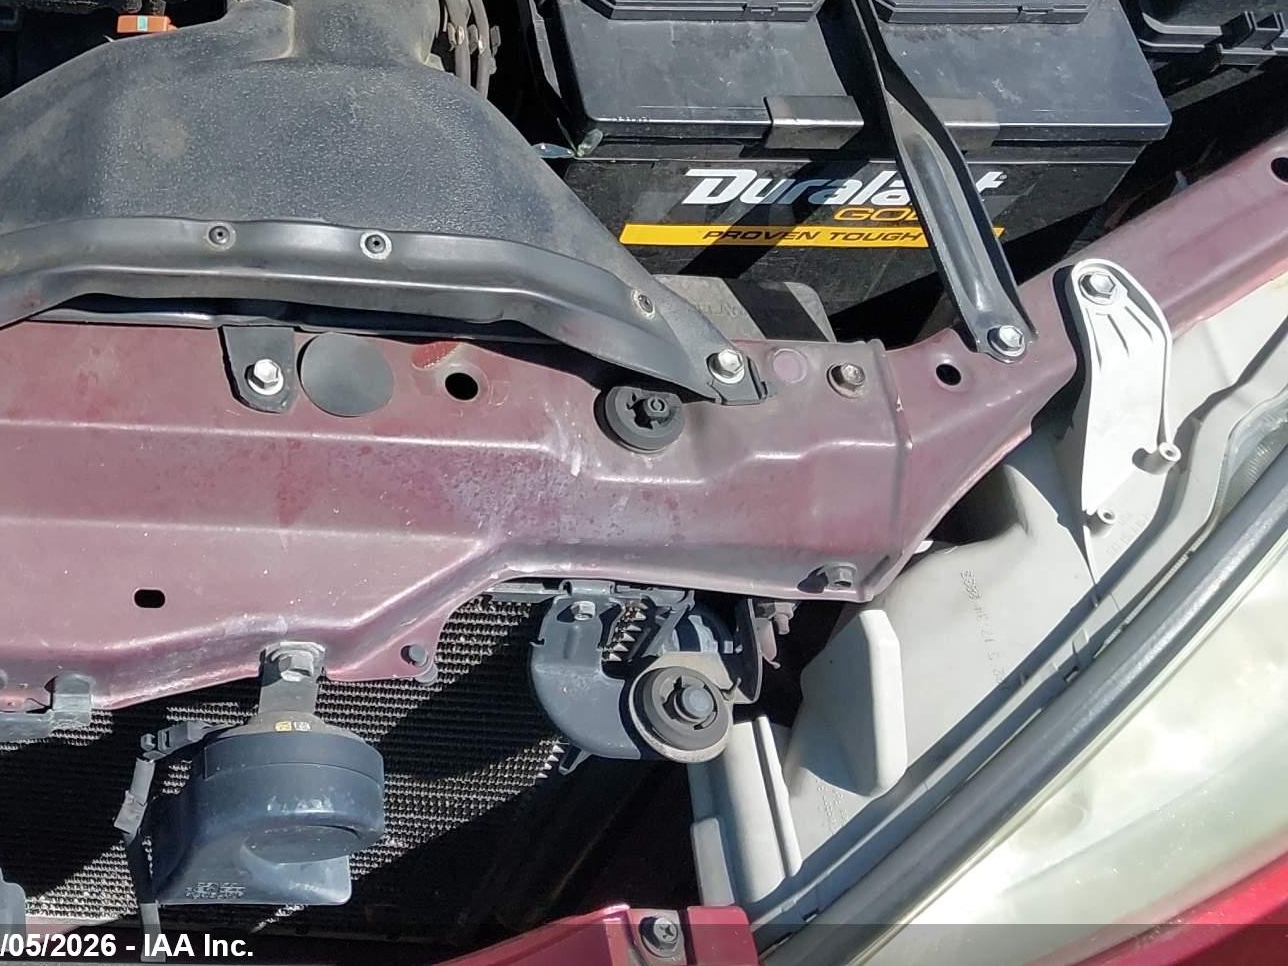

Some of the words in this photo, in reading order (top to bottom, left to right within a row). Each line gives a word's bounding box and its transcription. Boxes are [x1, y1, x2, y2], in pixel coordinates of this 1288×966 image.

[681, 169, 1006, 206] Duralat
[834, 207, 920, 222] GO
[702, 230, 819, 241] PROVEN
[829, 231, 925, 242] TOUGH
